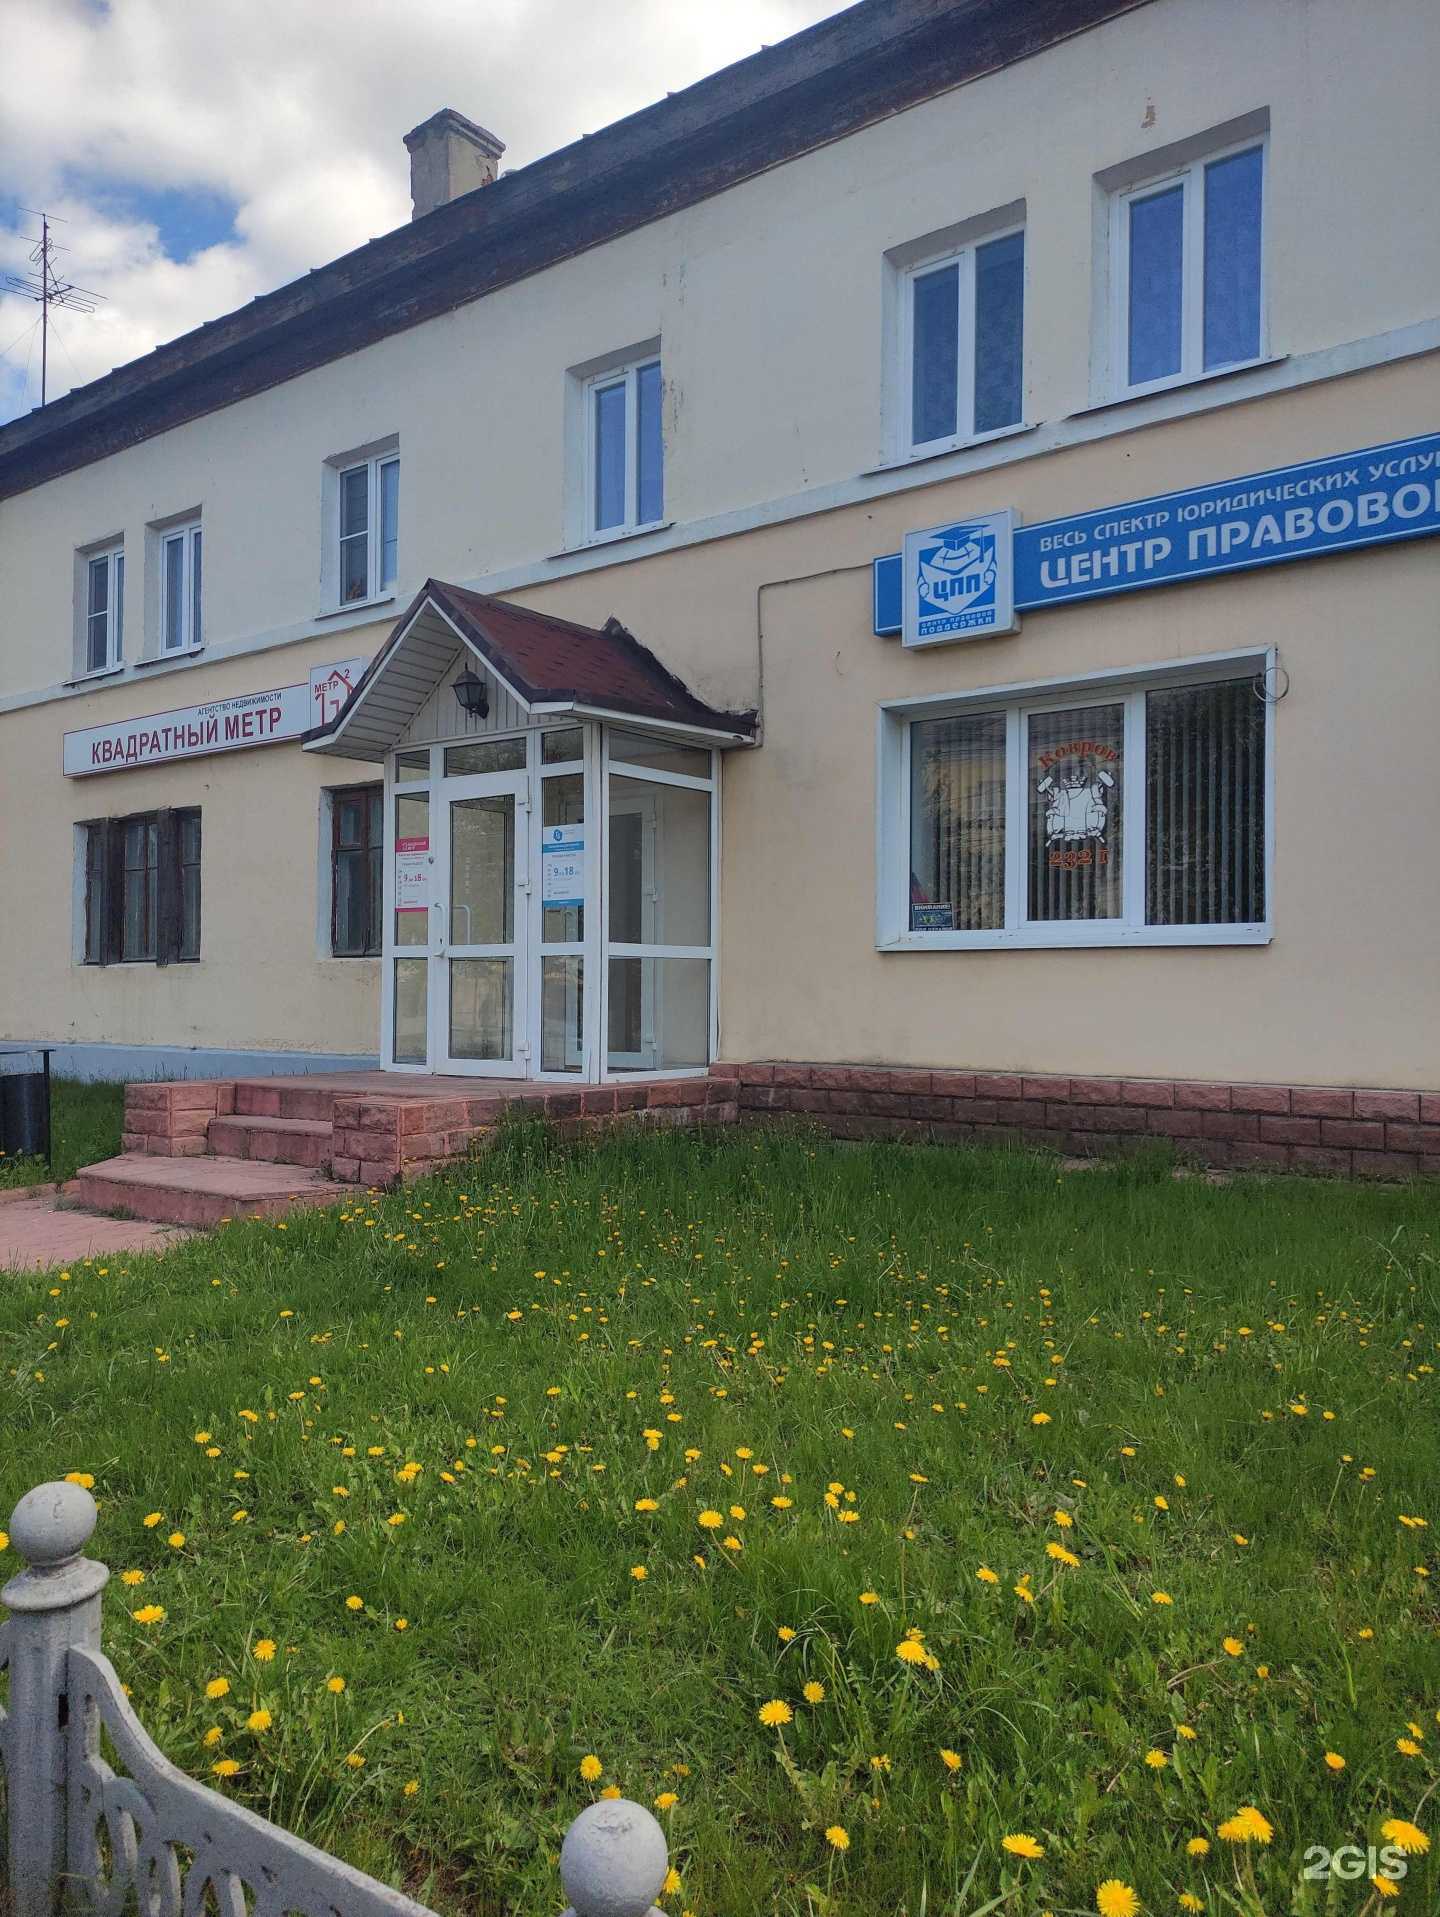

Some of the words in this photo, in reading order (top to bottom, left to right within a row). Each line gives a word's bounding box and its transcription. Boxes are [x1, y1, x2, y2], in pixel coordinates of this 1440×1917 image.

[1040, 530, 1087, 552] ВЕСЬ
[1093, 511, 1170, 540] СПЕКТР
[1177, 468, 1360, 523] ЮРИДИЧЕСКИХ
[1040, 536, 1172, 589] ЦЕНТР
[932, 573, 981, 602] ЦПП
[314, 680, 339, 694] МЕТР
[344, 668, 351, 679] 2
[197, 702, 231, 716] АГЕНТСТВО
[231, 692, 282, 709] НЕДВИЖИМОСТИ
[92, 712, 218, 765] КВАДРАТНЫЙ
[224, 707, 282, 741] МЕТР
